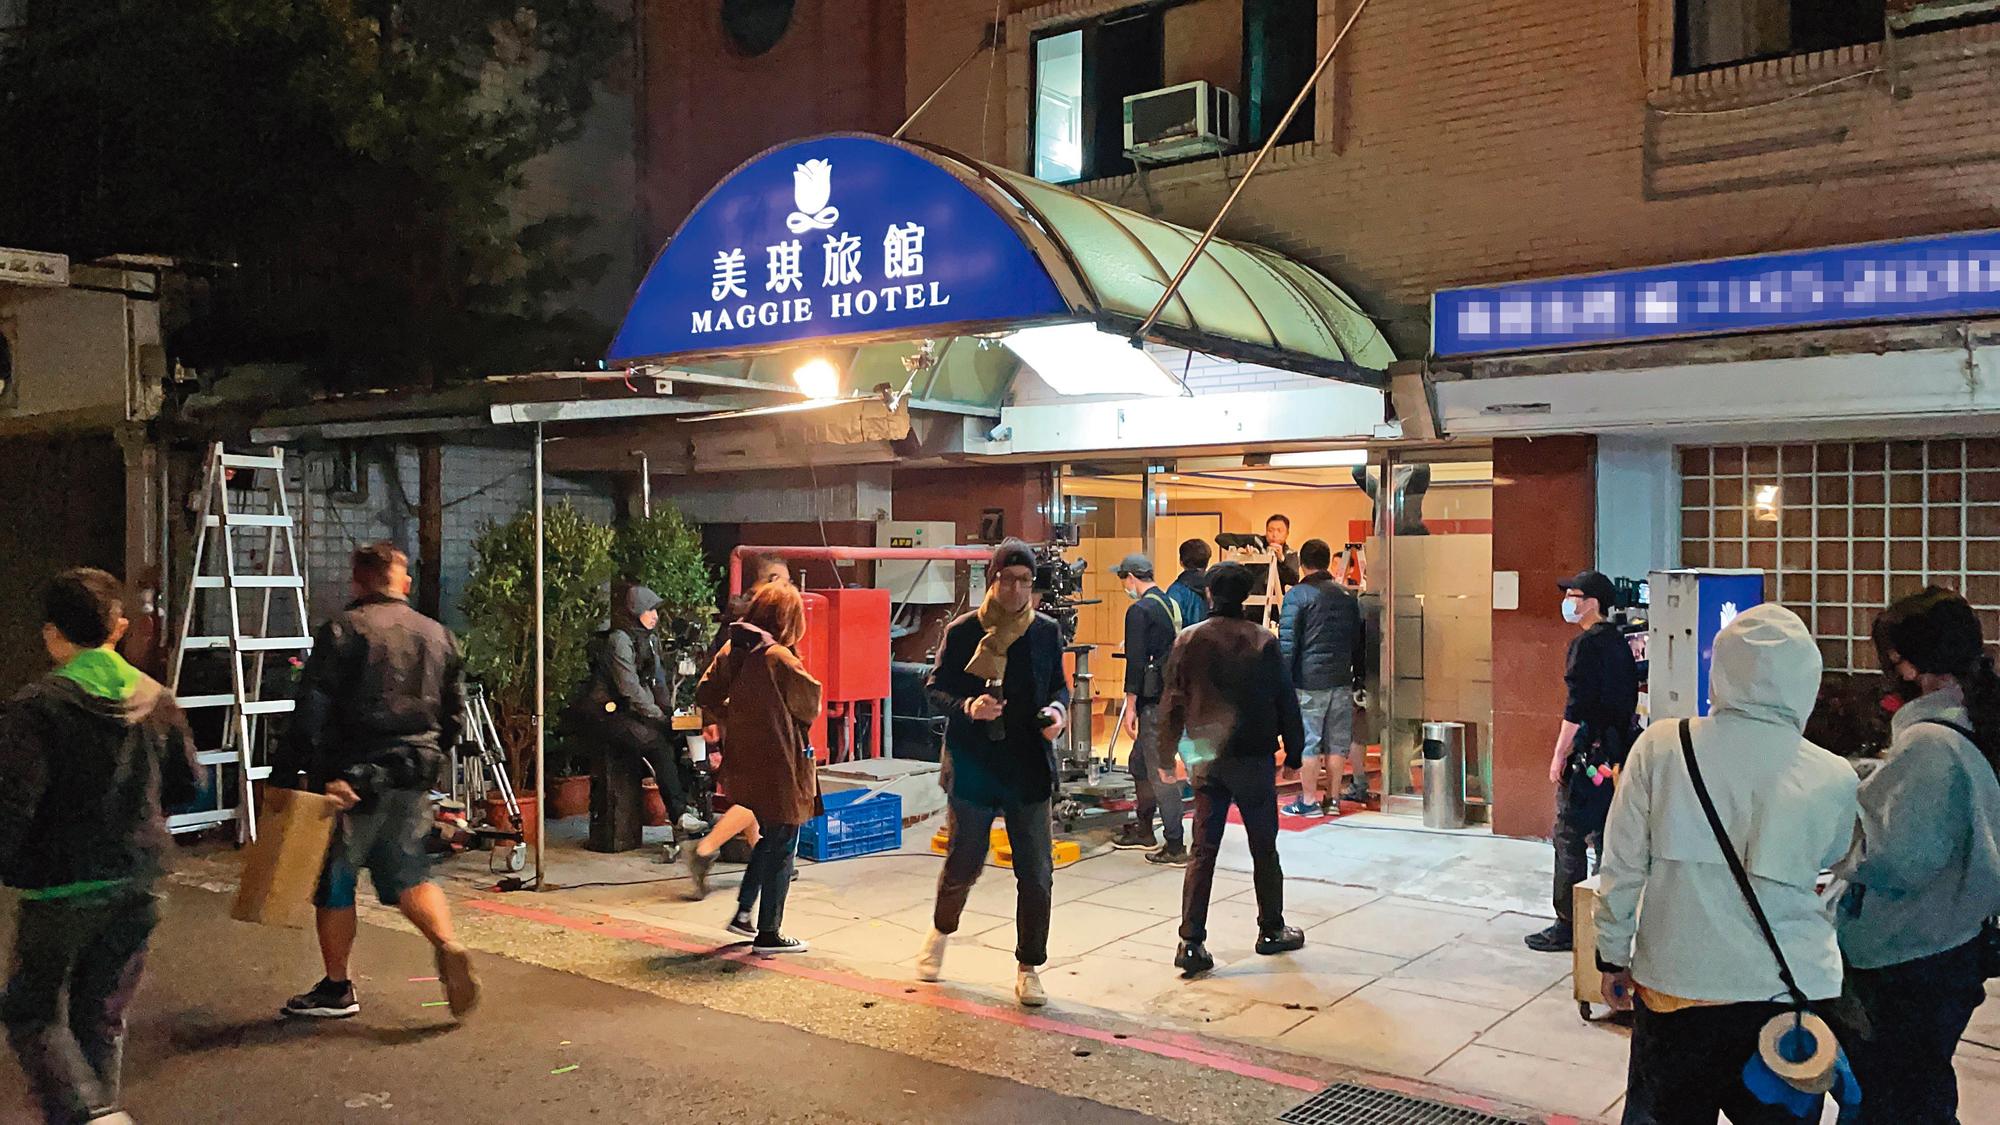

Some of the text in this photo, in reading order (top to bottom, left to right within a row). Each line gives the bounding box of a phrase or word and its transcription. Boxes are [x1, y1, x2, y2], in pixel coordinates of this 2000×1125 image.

[711, 221, 925, 302] 美琪旅館
[691, 281, 950, 334] MAGGIE HOTEL
[982, 512, 1001, 540] 7
